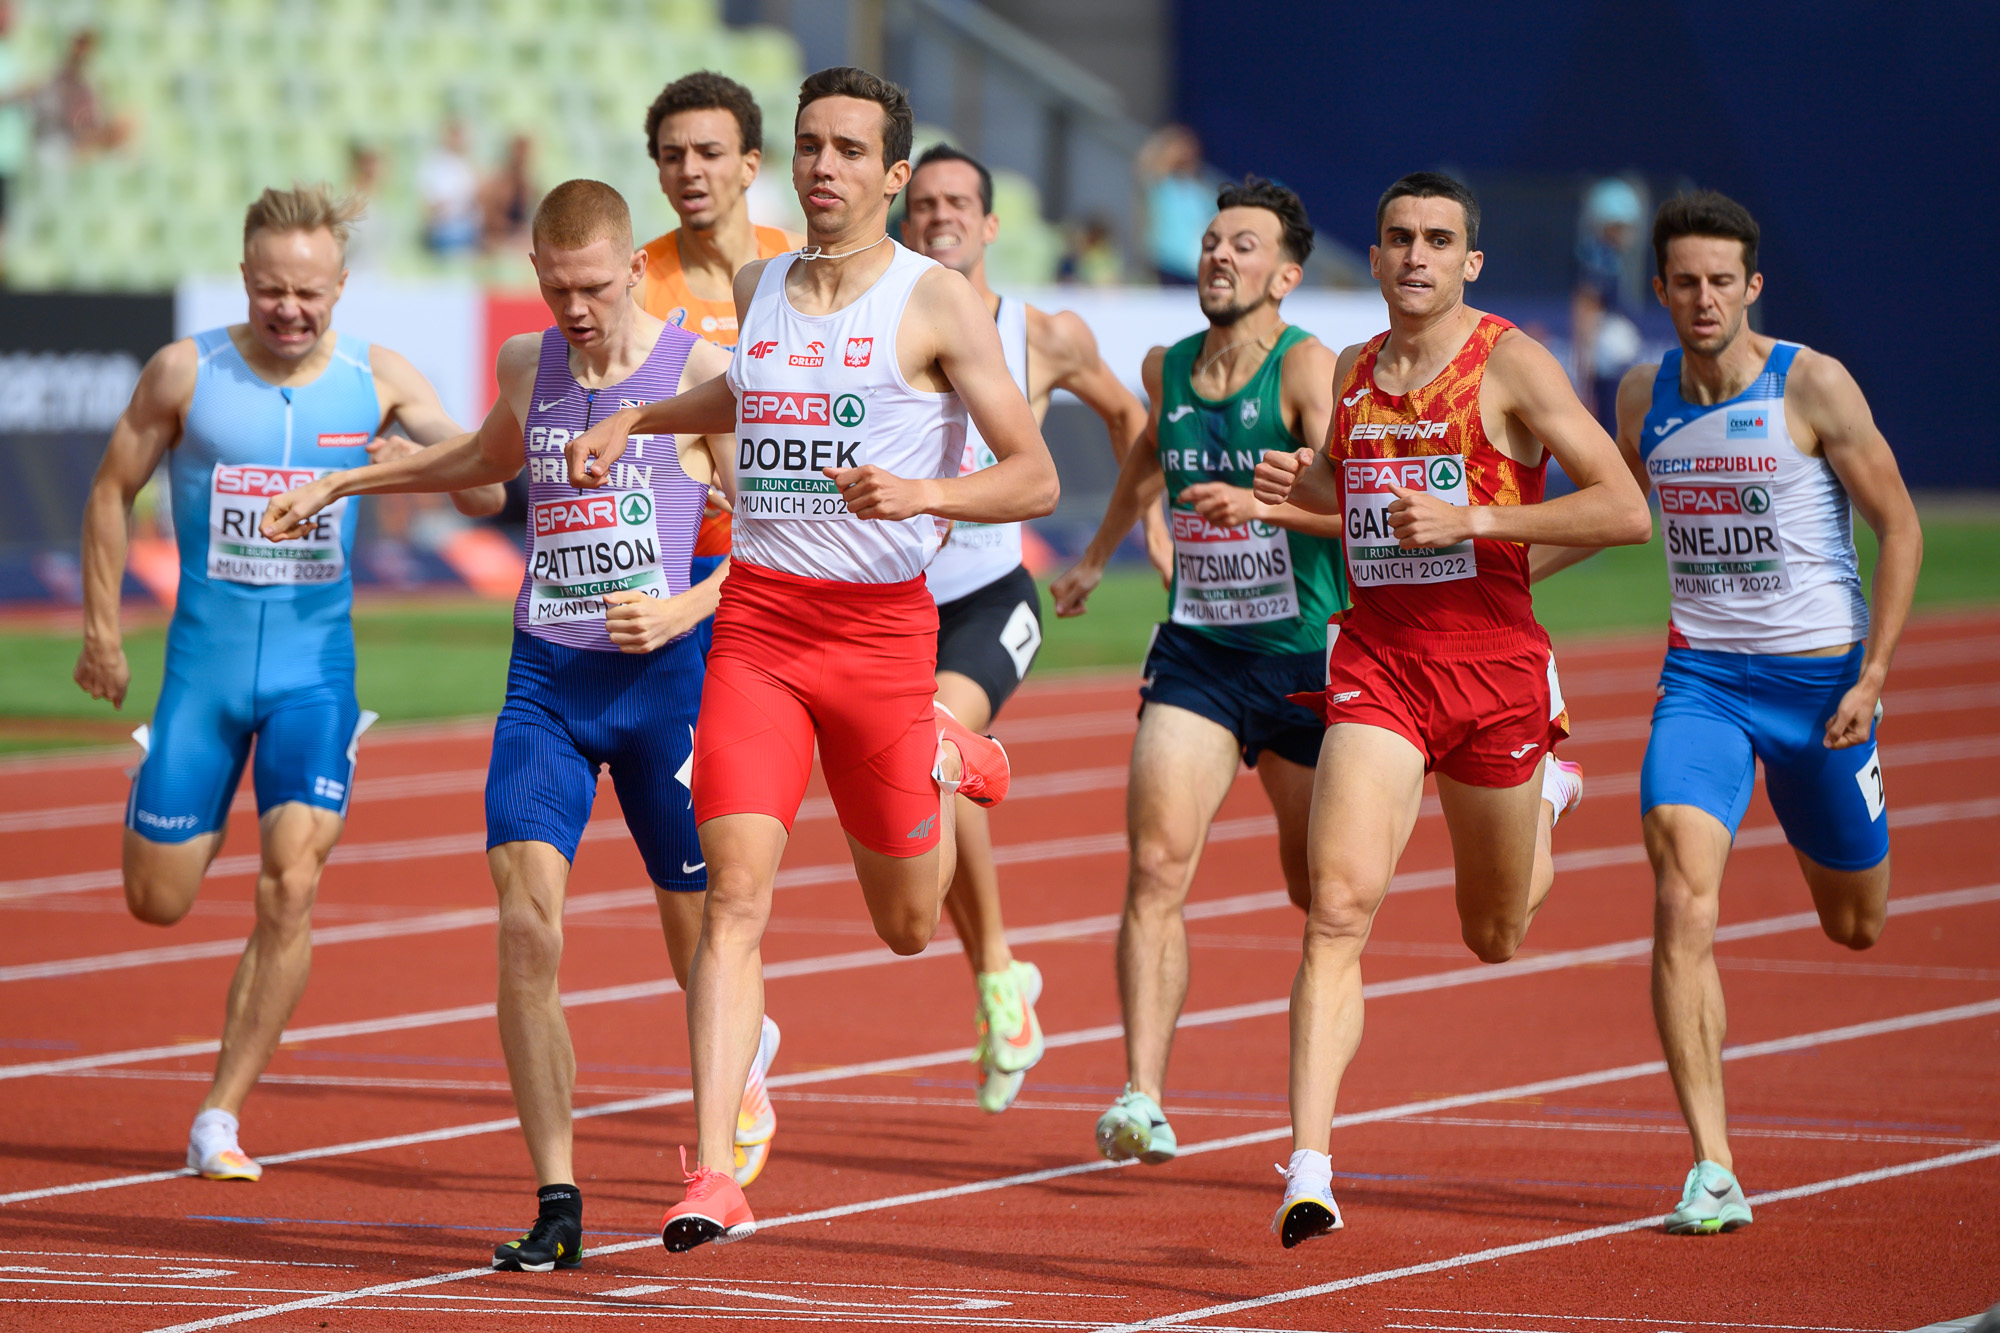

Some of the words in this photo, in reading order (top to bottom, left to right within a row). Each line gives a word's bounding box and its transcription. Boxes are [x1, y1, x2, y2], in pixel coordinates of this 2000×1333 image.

[747, 340, 779, 359] 4F
[790, 356, 822, 366] ORLEN
[744, 395, 828, 421] SPAR
[1349, 420, 1450, 440] ESPAÑA
[529, 427, 655, 458] GRT
[739, 438, 862, 472] DOBEK
[1650, 458, 1691, 475] CZECH
[1695, 456, 1778, 473] REPUBLIC
[529, 457, 653, 489] BRIIN
[1347, 464, 1425, 490] SPAR
[761, 479, 788, 491] RUN
[740, 495, 806, 514] MUNICH
[812, 498, 849, 515] 202
[1662, 489, 1739, 512] SPAR
[222, 508, 332, 541] RIE
[537, 500, 614, 532] SPAR
[1668, 519, 1779, 556] ŠNEJDR
[246, 546, 273, 558] RUN
[533, 537, 656, 580] PATTISON
[1370, 547, 1395, 558] RUN
[216, 559, 287, 578] MUNICH
[293, 563, 336, 580] 2022
[1178, 548, 1287, 583] FITZSIMONS
[1353, 562, 1414, 582] MUNICH
[1419, 558, 1467, 579] 2022
[1694, 563, 1716, 574] RUN
[564, 585, 587, 597] RUN
[1675, 577, 1735, 595] MUNICH
[1739, 576, 1783, 593] 2022
[538, 599, 609, 620] MUNICH
[1183, 603, 1242, 621] MUNICH
[1247, 599, 1290, 620] 2022
[1015, 623, 1034, 651] 7
[1333, 690, 1361, 704] ESP
[138, 809, 187, 829] CRAFT
[907, 813, 937, 839] 4F
